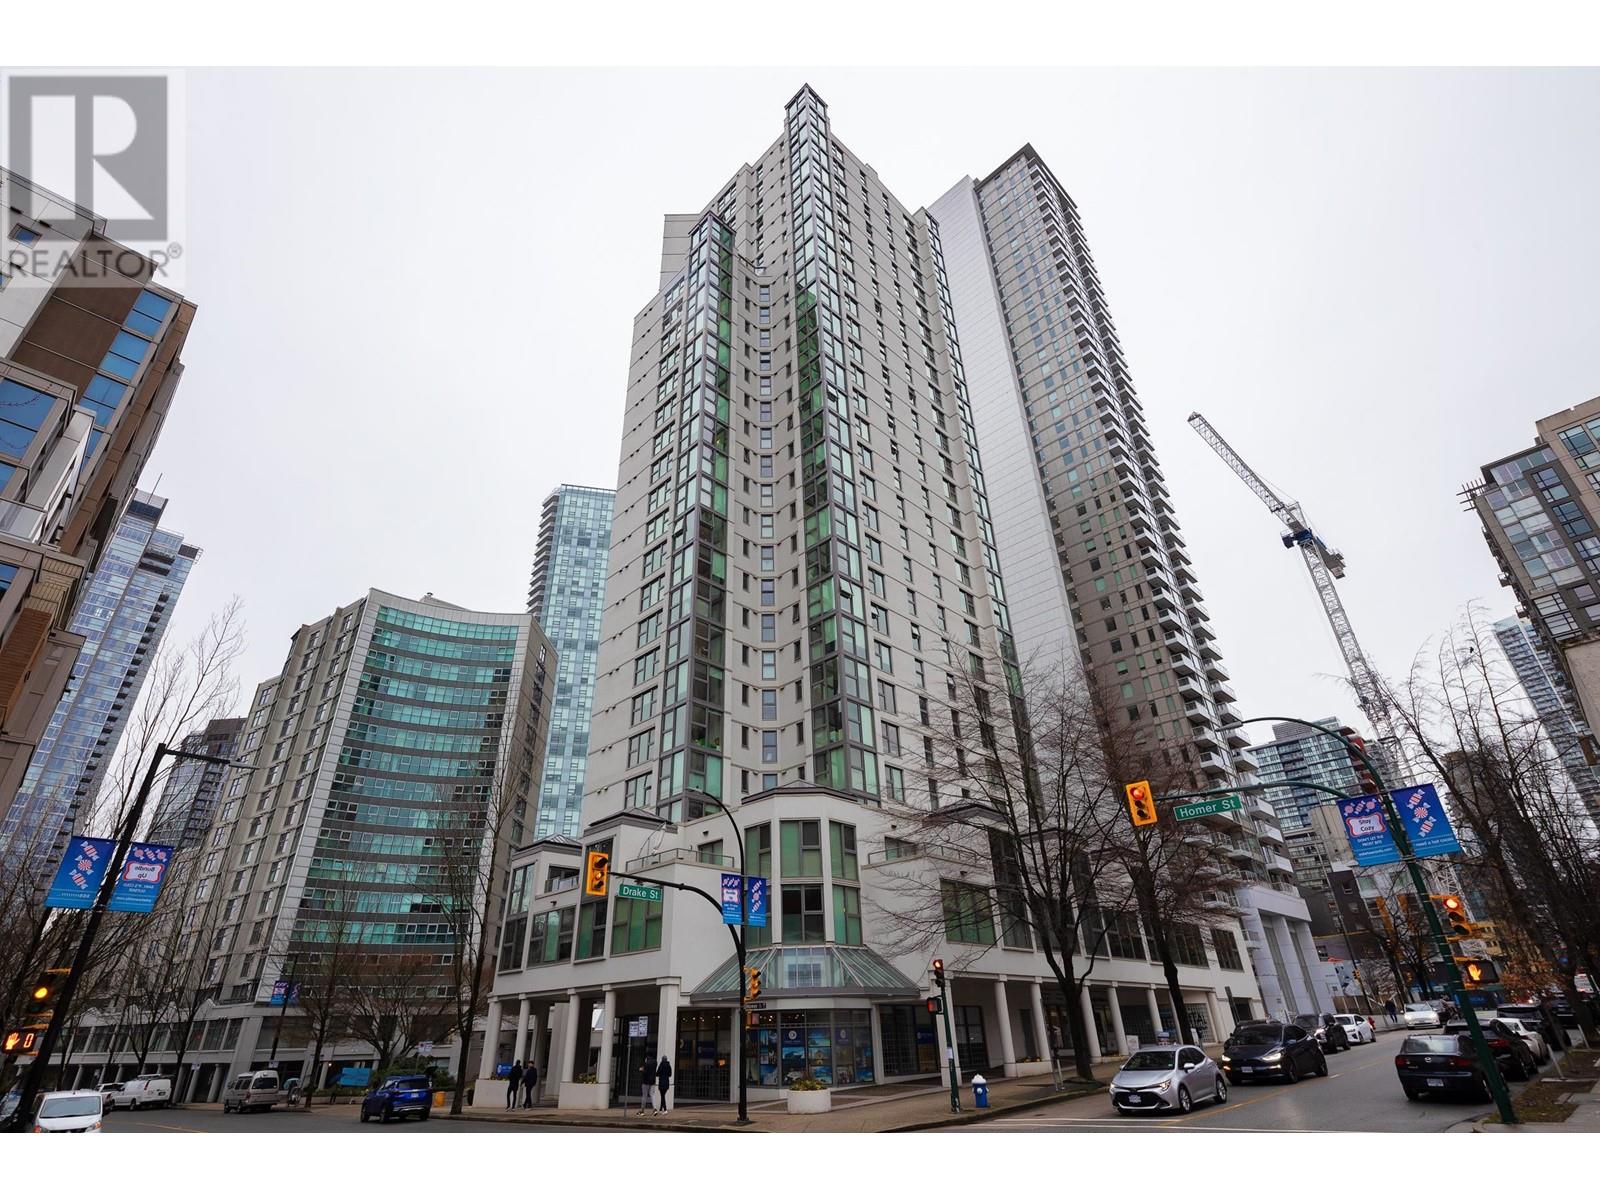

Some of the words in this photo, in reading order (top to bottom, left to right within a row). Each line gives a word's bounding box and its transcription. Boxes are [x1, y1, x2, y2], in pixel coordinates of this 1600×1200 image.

[1180, 803, 1217, 817] Homer
[1221, 799, 1236, 809] St
[622, 886, 647, 897] Drake
[649, 889, 659, 899] St
